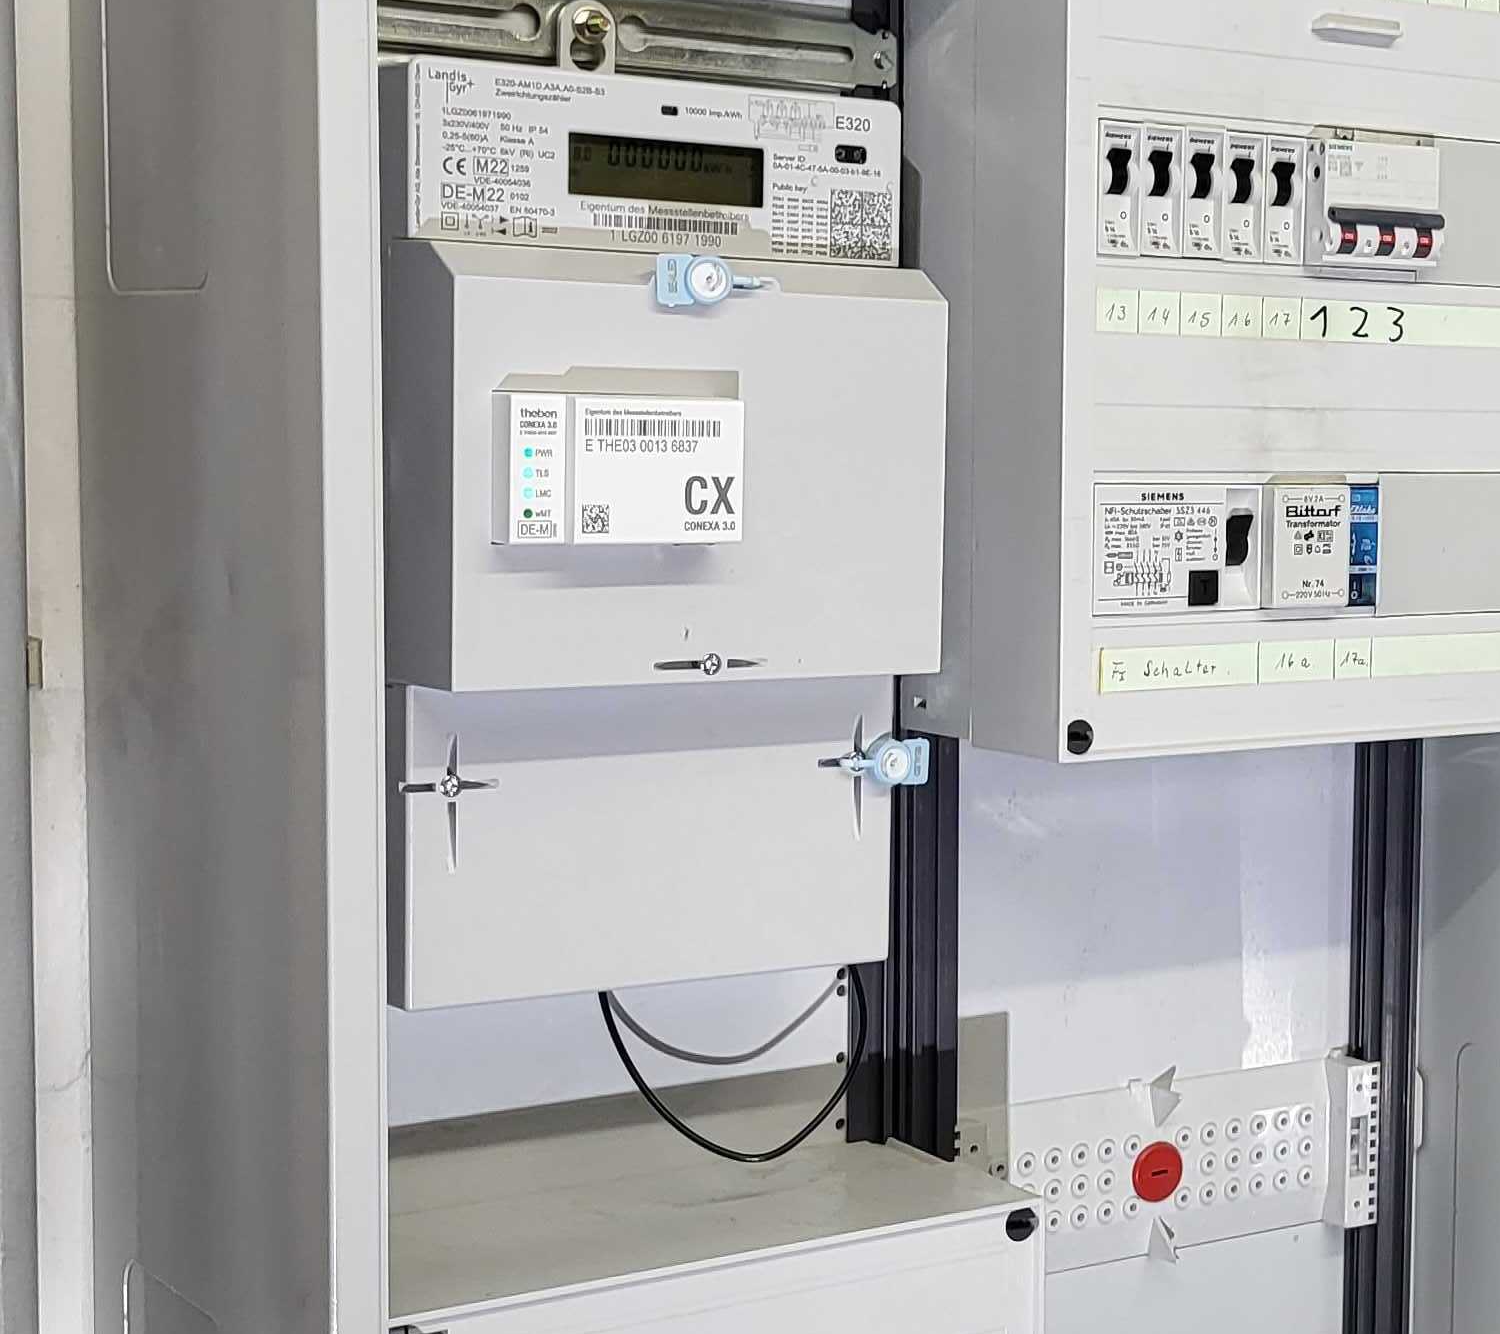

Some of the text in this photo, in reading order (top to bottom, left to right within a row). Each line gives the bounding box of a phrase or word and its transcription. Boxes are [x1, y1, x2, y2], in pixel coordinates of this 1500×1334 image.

[428, 68, 467, 82] Landis
[685, 106, 707, 116] 10000
[835, 116, 871, 132] E320
[476, 158, 508, 175] M22
[442, 183, 505, 203] DE-M22
[580, 200, 626, 215] Eigentum
[628, 204, 645, 215] des
[622, 231, 657, 244] LGZ00
[662, 233, 689, 246] 6197
[695, 235, 721, 248] 1990
[1105, 302, 1405, 342] 13 14 15 16 17 1 2 3
[585, 438, 699, 453] E THE03 0013 6837
[684, 475, 735, 515] CX
[1141, 492, 1184, 501] SIEMENS
[1286, 505, 1341, 517] Bittorf
[520, 524, 549, 536] DE-M
[684, 521, 736, 531] CONEXA 3.0
[1286, 519, 1341, 528] Transformator
[1302, 579, 1325, 588] Nr. 74
